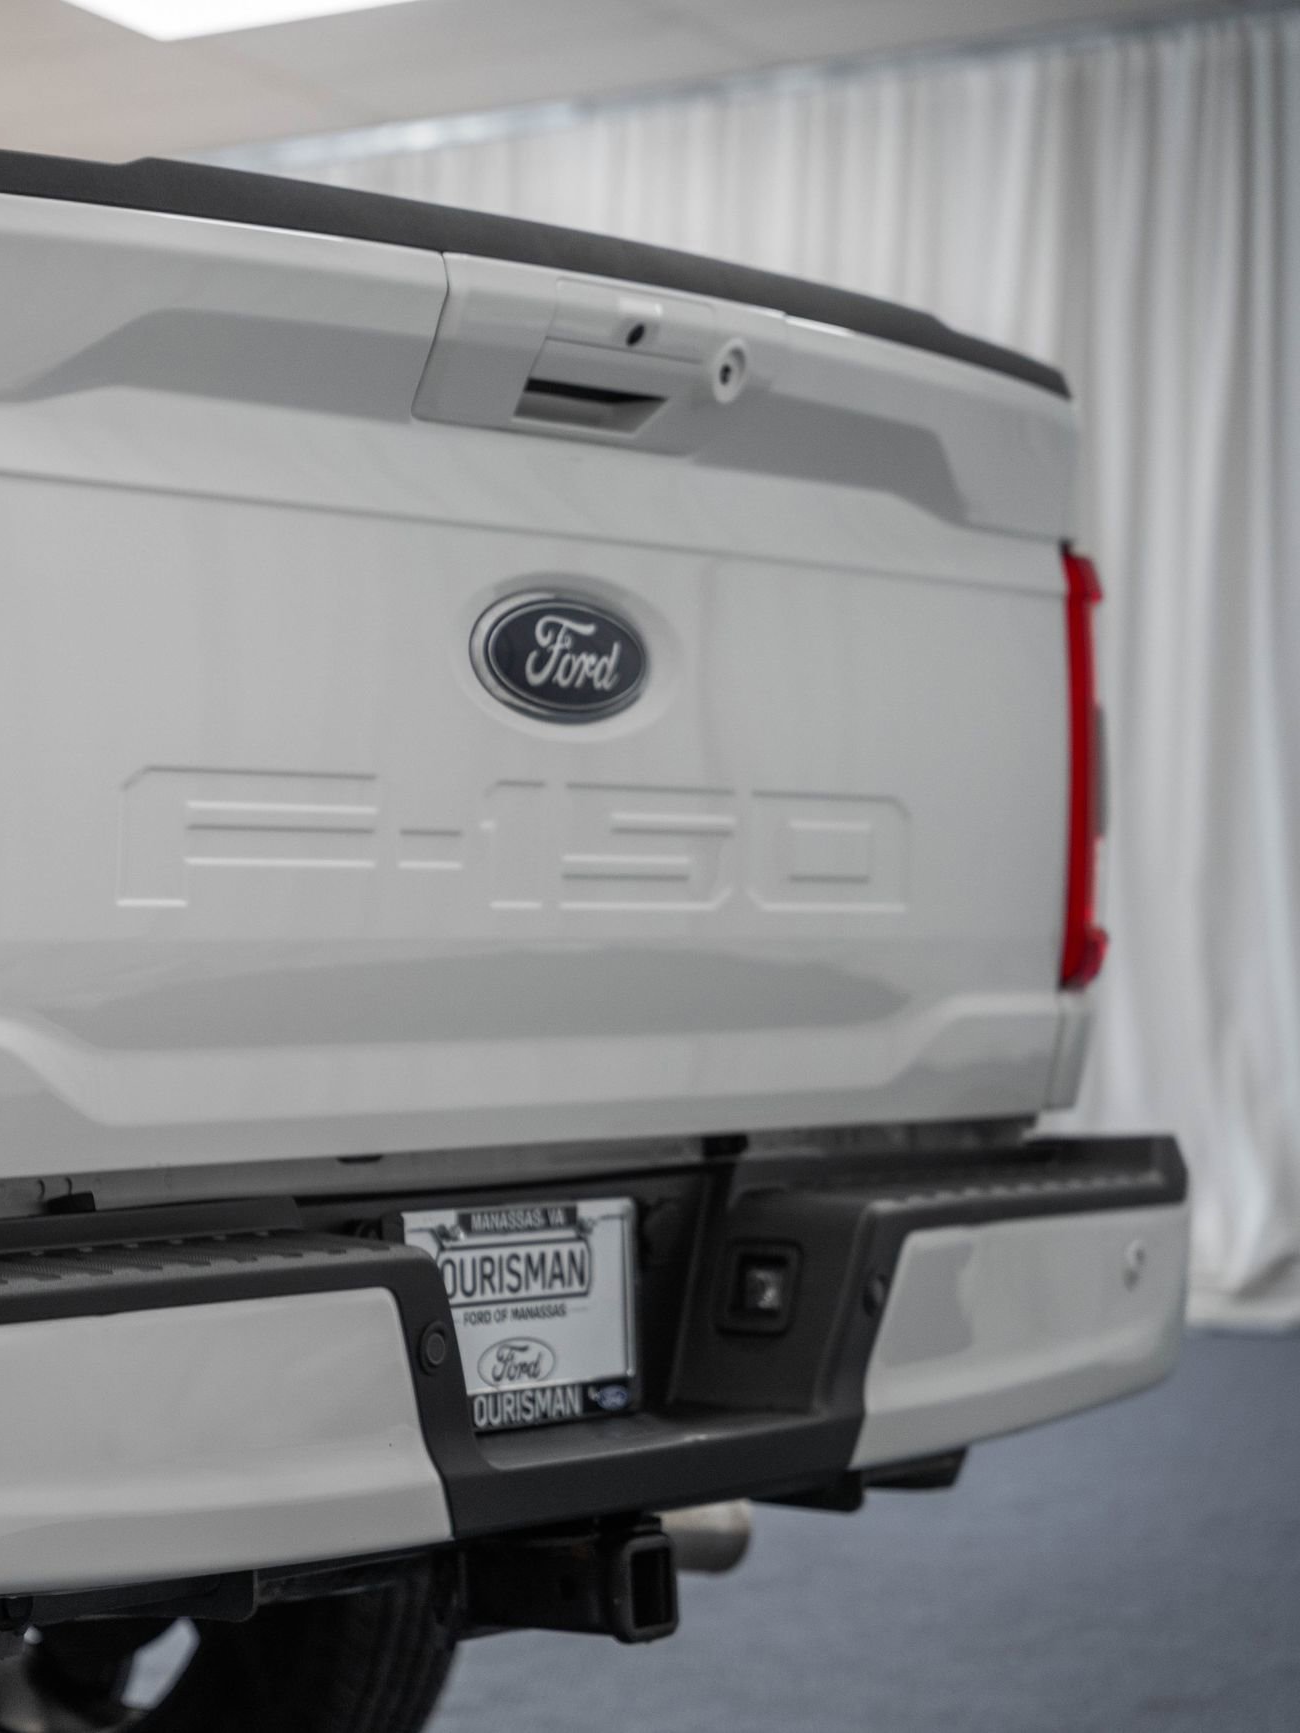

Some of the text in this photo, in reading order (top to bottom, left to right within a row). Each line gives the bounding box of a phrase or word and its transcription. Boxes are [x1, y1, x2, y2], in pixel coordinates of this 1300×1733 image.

[524, 614, 622, 692] Ford
[114, 764, 912, 914] F-150
[548, 1207, 565, 1226] VA
[442, 1249, 586, 1298] OURISMAN
[463, 1303, 567, 1326] FORD OF MANASSAS
[490, 1344, 542, 1382] Ford
[473, 1386, 581, 1427] OURISMAN
